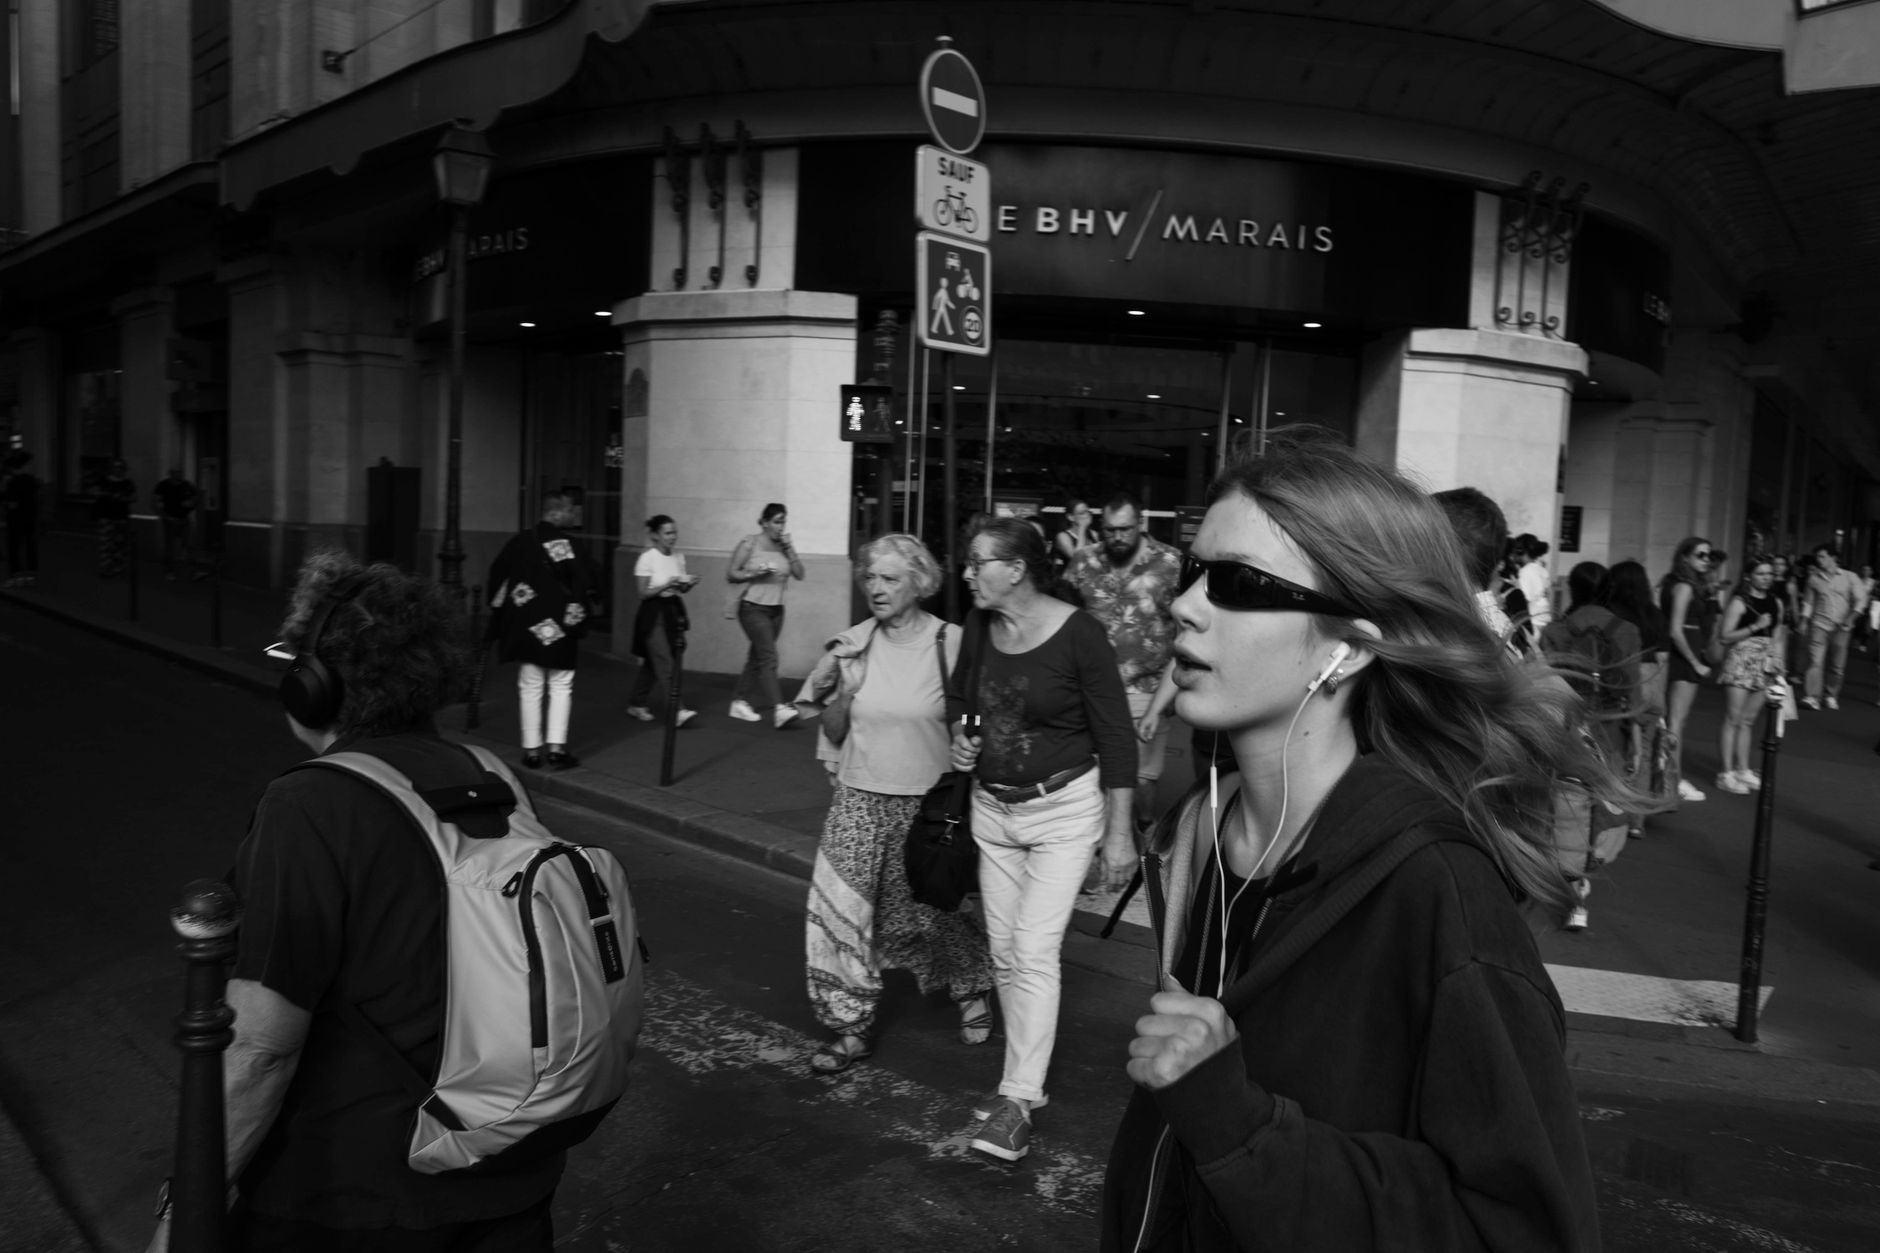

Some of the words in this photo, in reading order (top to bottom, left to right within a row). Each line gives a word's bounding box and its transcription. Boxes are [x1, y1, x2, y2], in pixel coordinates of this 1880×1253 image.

[938, 157, 975, 183] SAUF
[468, 227, 529, 257] ARAIS
[997, 205, 1017, 232] E
[1035, 207, 1128, 237] BHV
[1162, 214, 1335, 253] MARAIS
[966, 317, 980, 333] 20
